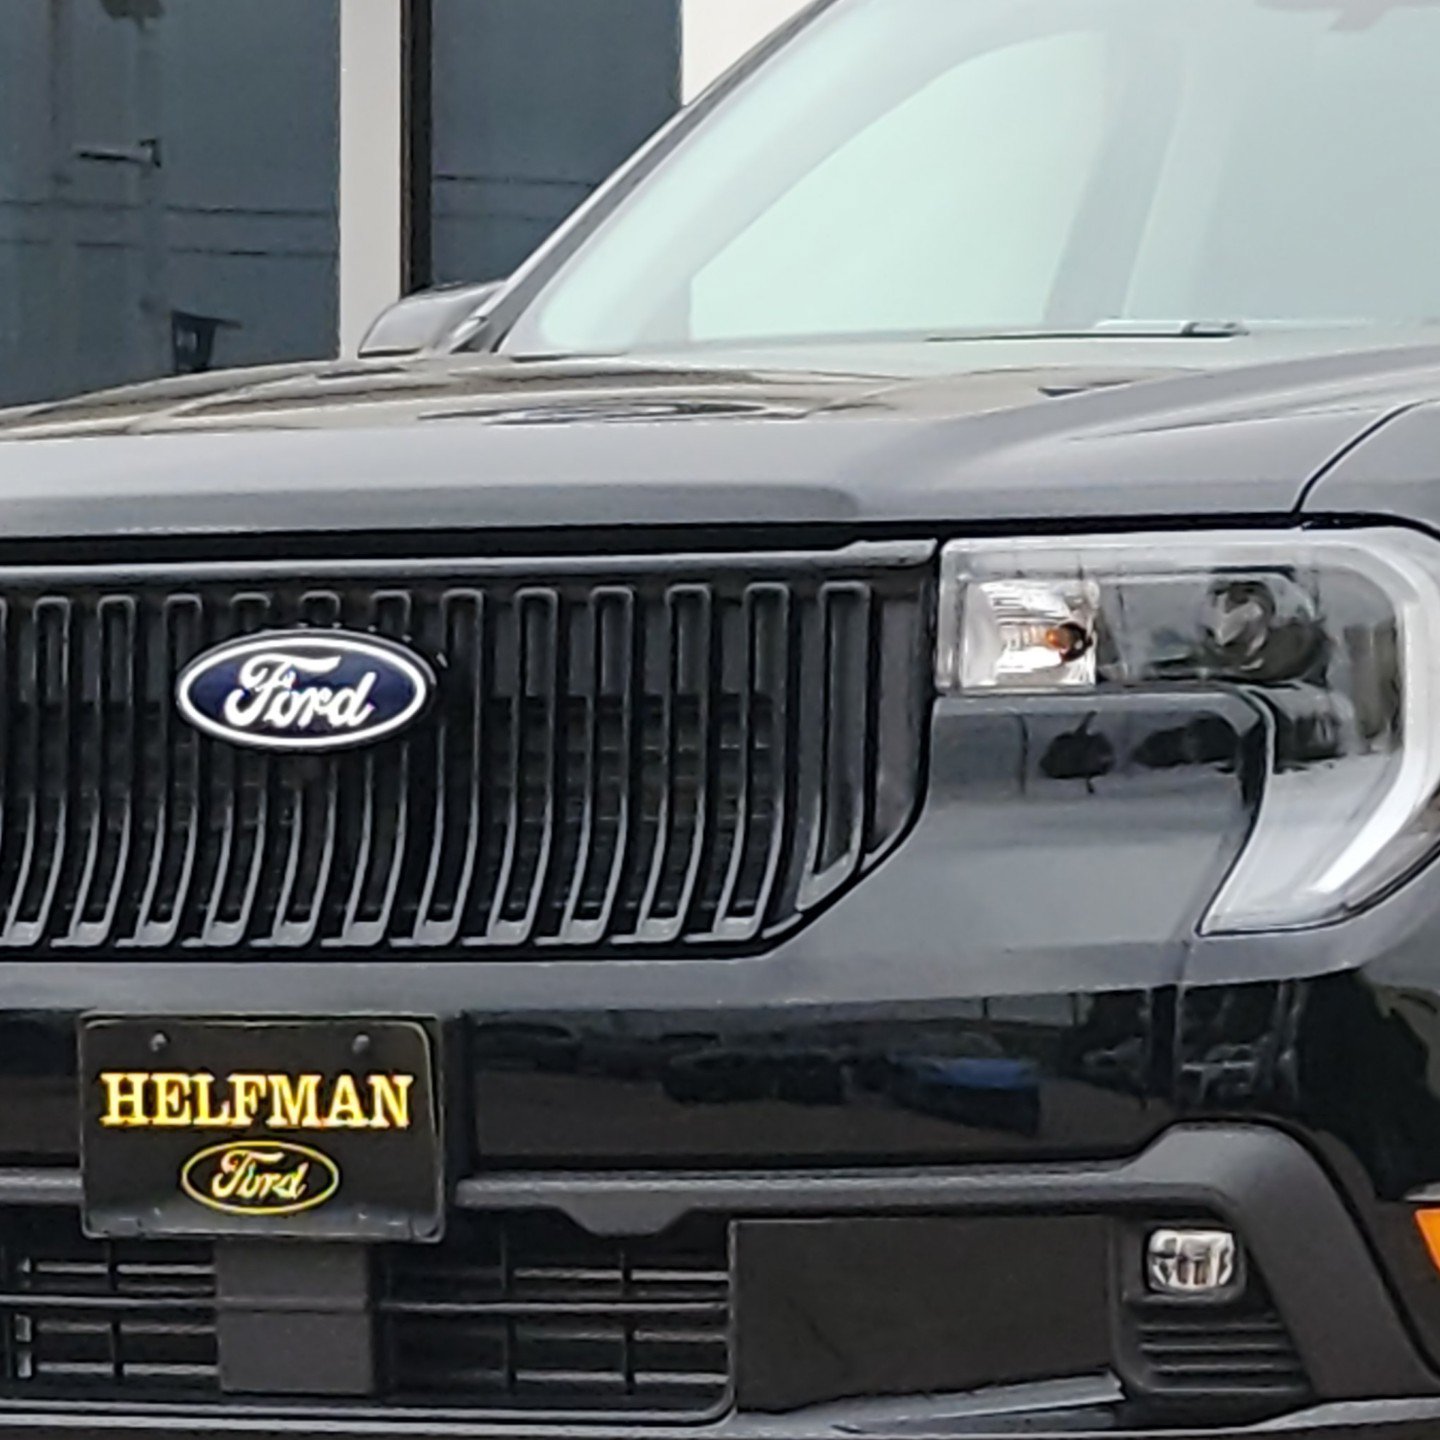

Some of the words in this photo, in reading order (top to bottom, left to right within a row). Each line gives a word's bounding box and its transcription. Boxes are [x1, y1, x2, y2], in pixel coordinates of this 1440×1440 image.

[222, 652, 377, 728] Ford
[98, 1071, 415, 1128] HELFMAN
[211, 1149, 310, 1200] Ford
